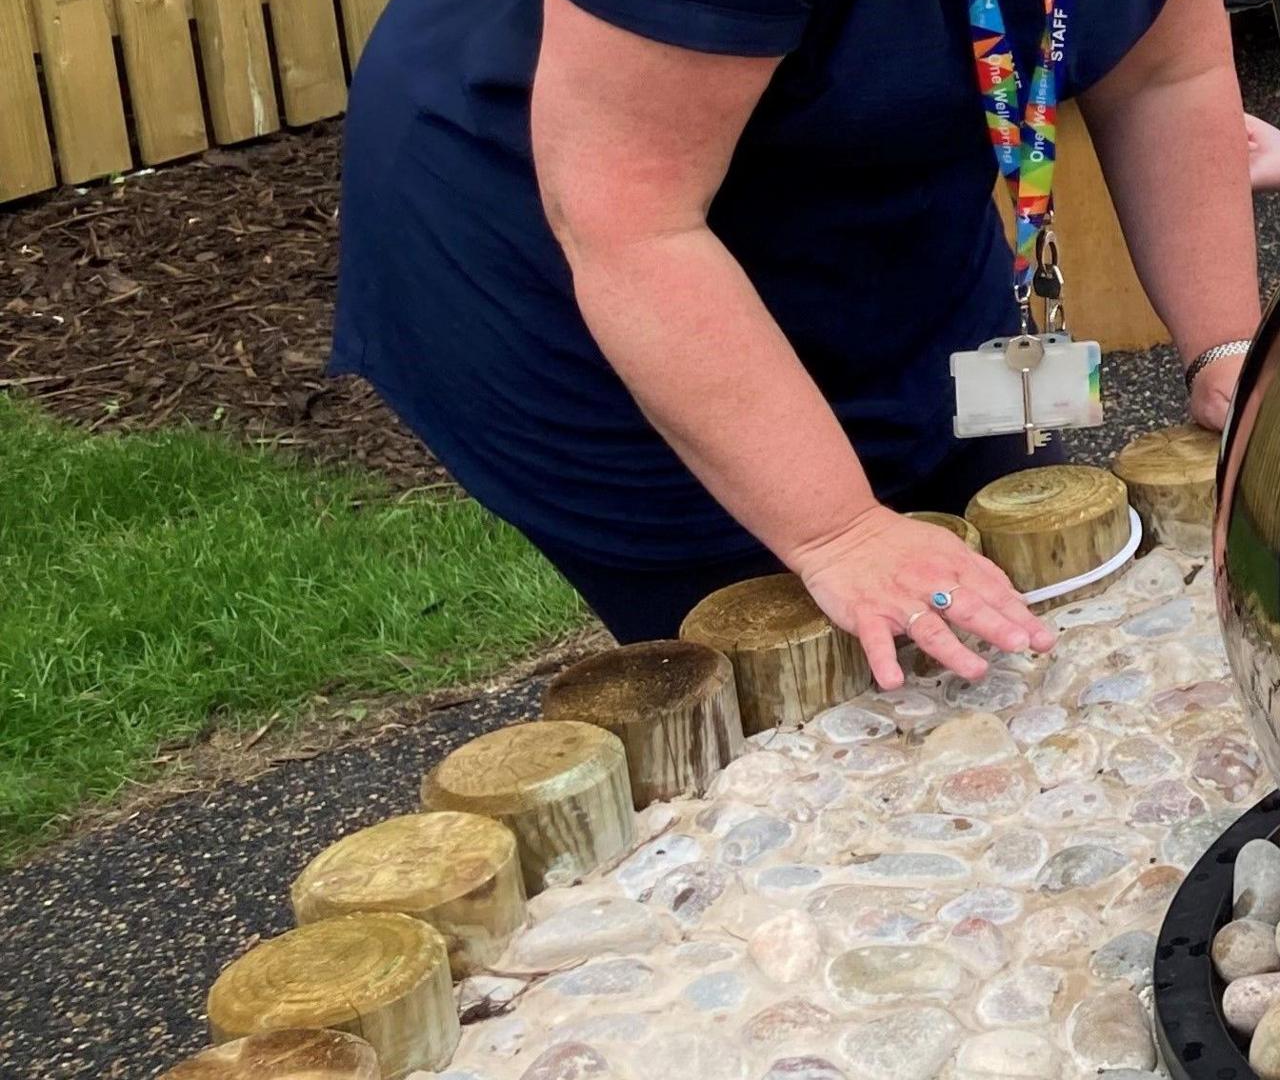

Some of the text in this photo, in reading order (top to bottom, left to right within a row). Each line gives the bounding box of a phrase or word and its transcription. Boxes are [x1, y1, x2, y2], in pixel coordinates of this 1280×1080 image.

[1050, 8, 1068, 61] STAFF
[989, 53, 1002, 84] One
[1029, 132, 1045, 162] One
